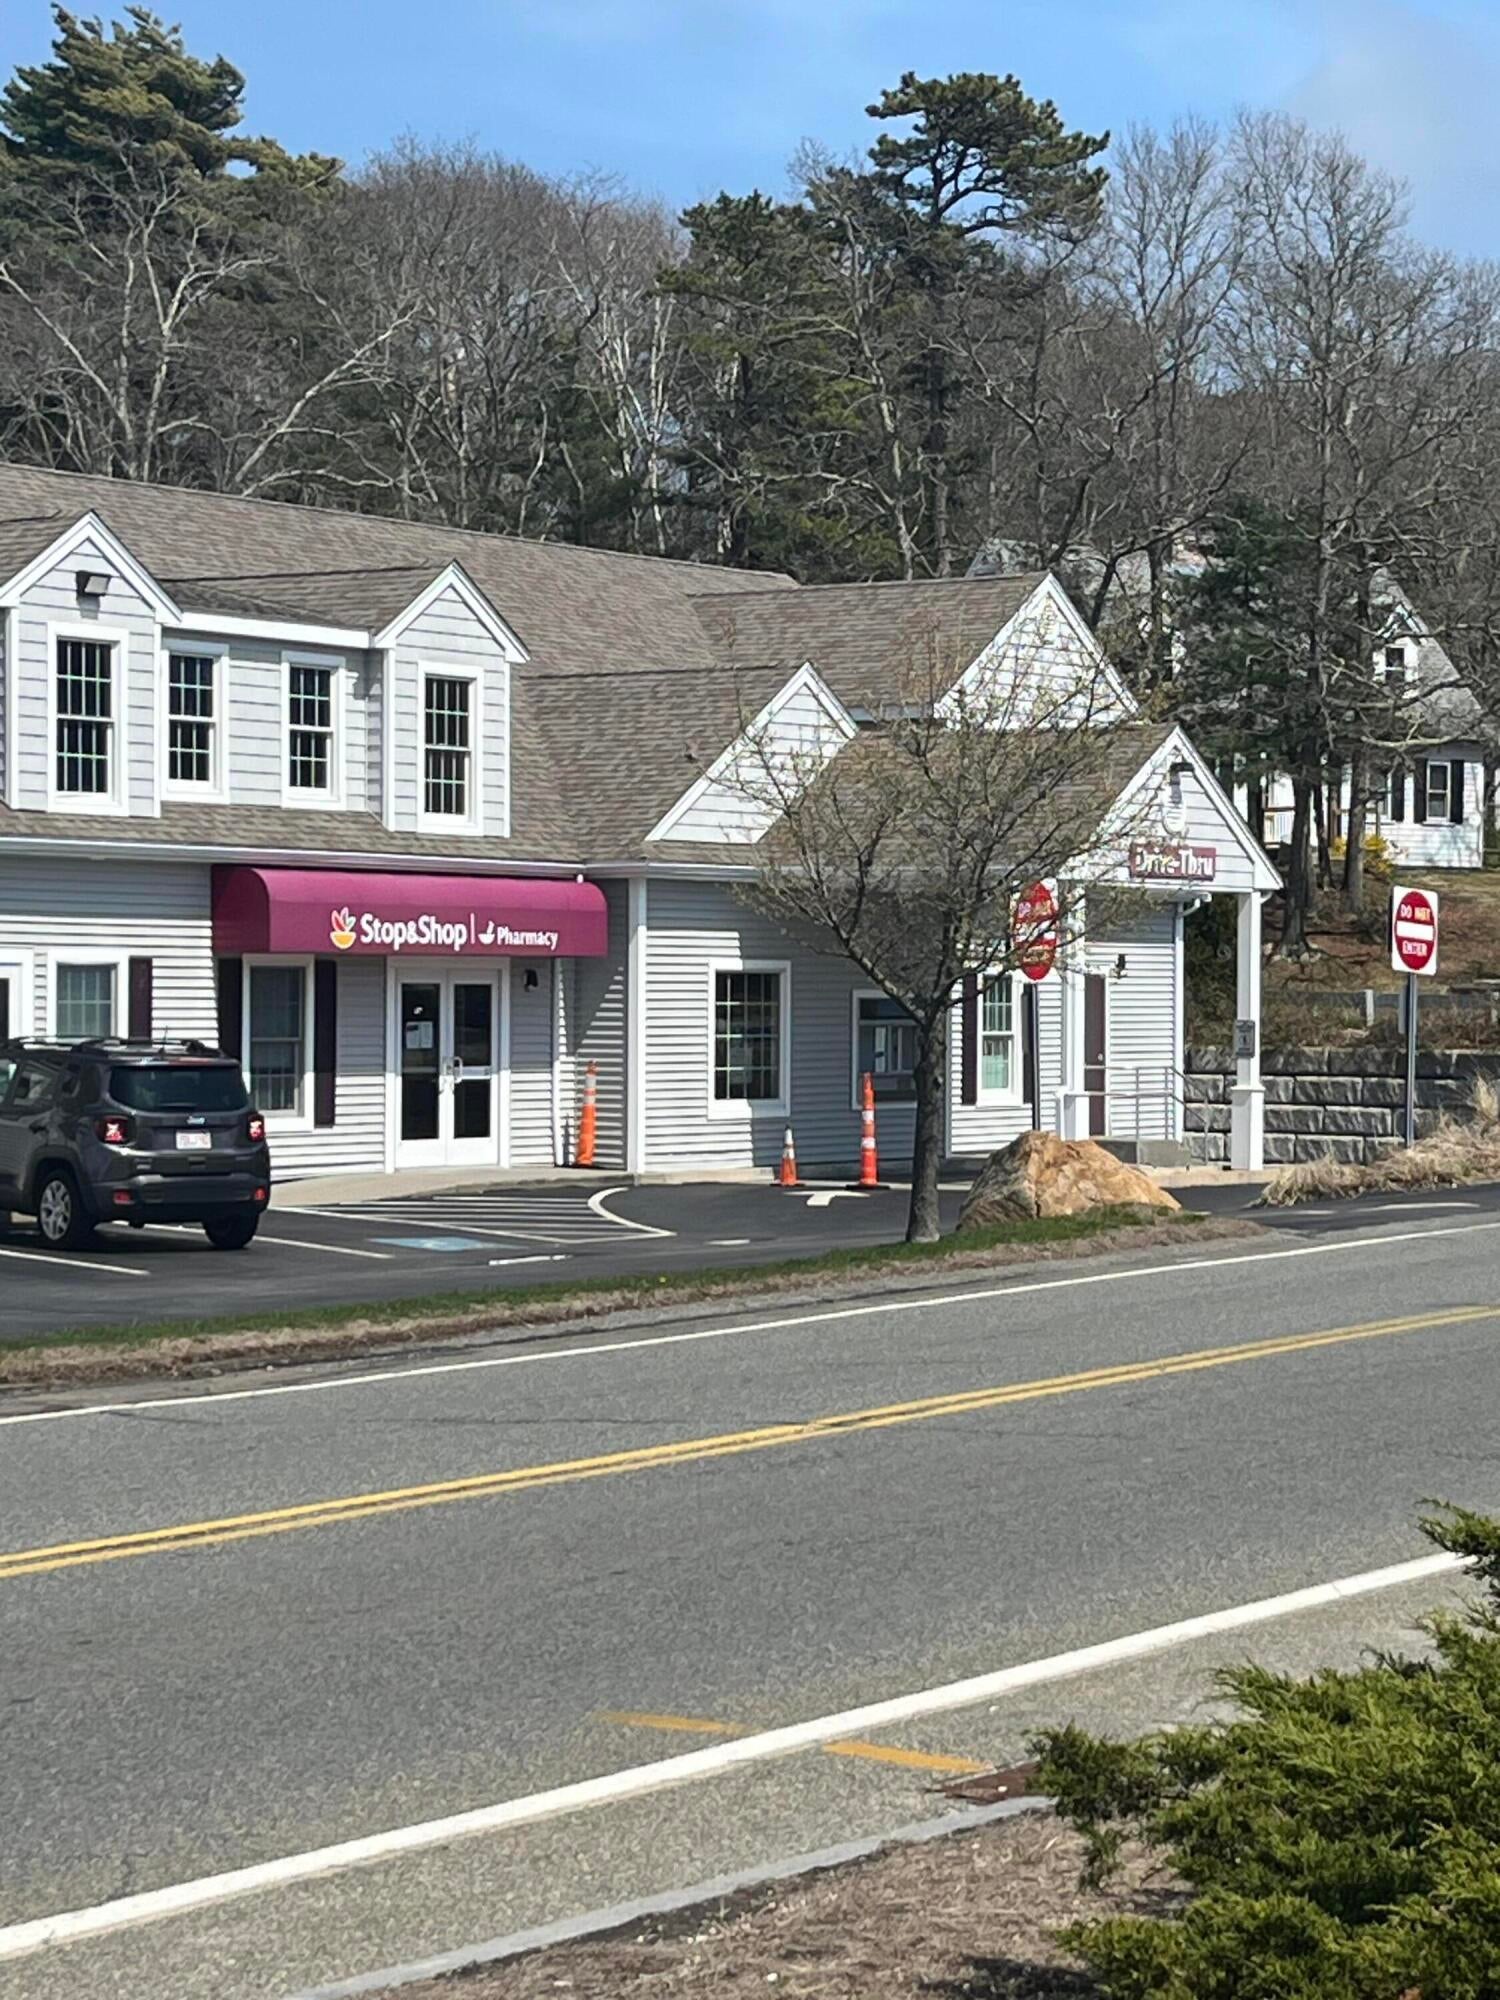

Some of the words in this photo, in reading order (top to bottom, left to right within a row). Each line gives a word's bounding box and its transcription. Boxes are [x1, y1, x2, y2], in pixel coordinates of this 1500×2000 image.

[1400, 903, 1413, 919] DO
[360, 912, 467, 951] Stop&Shop
[497, 926, 558, 951] Pharmacy
